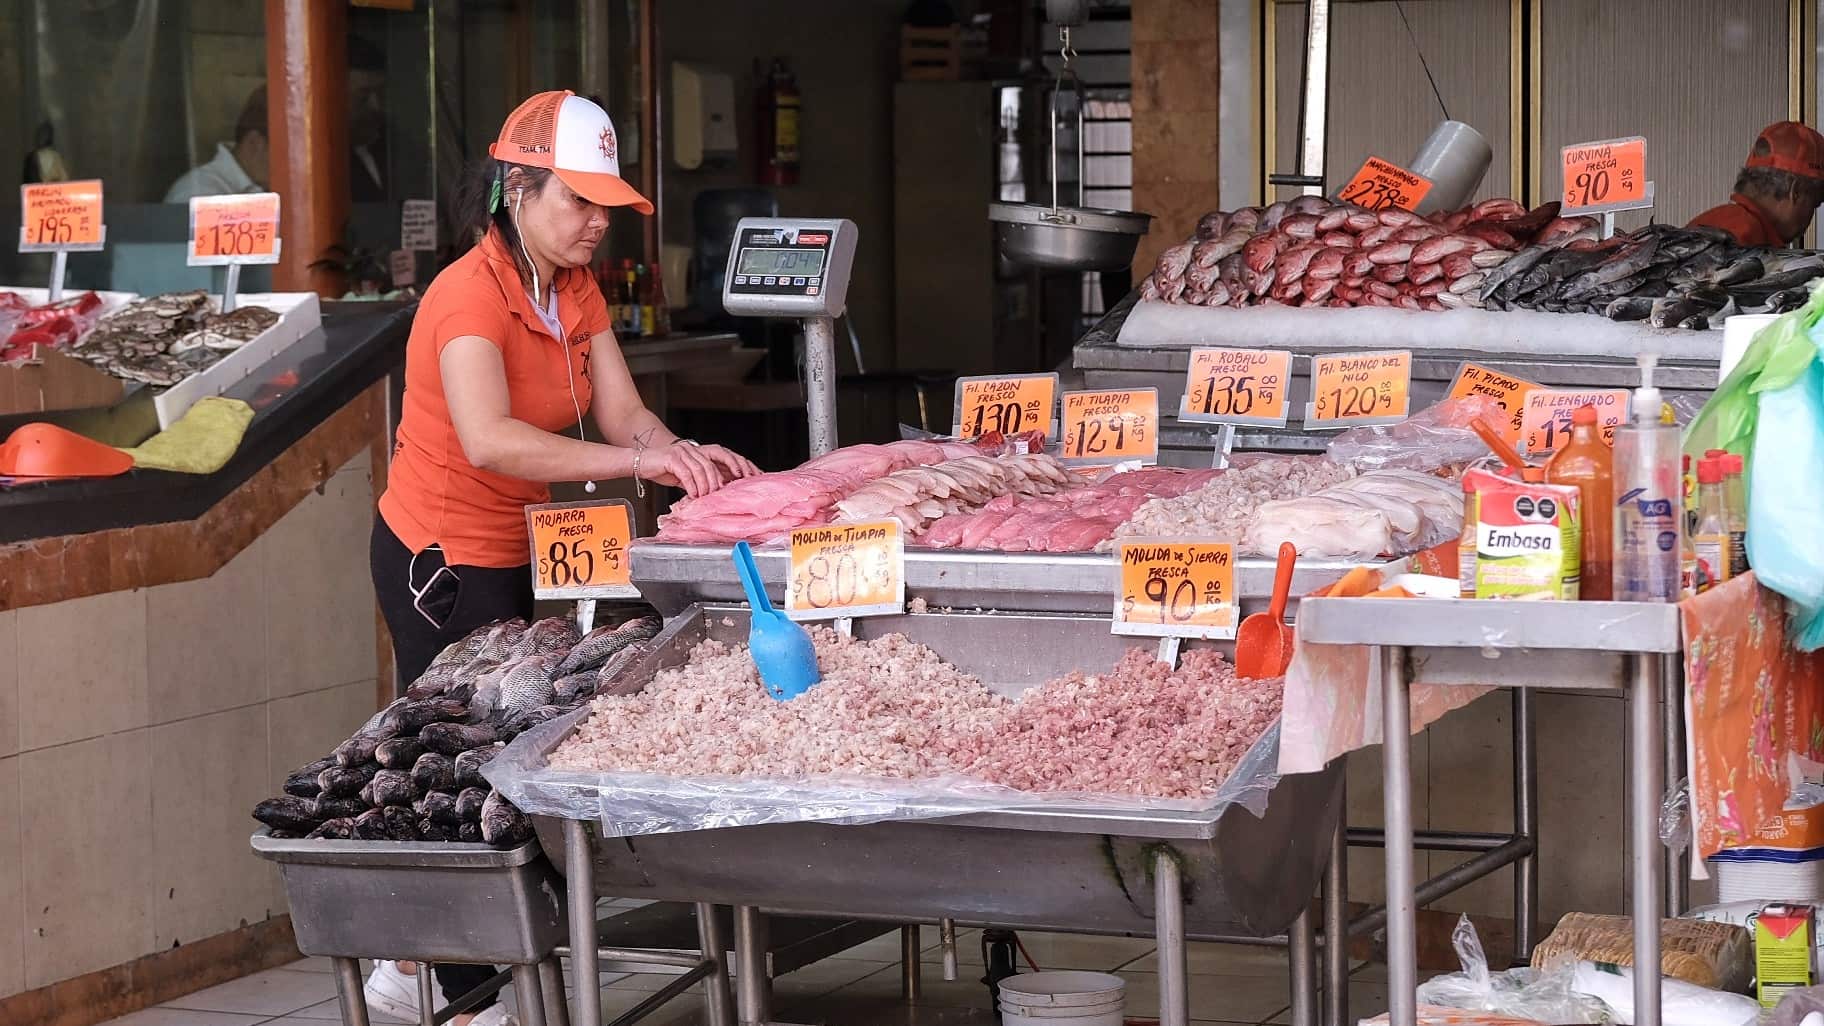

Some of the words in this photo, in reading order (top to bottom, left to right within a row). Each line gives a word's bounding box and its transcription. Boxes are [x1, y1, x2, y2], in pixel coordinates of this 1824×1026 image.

[1566, 146, 1611, 164] CURVINA
[1585, 158, 1617, 172] FRESCA
[1219, 352, 1268, 364] ROBALO
[1210, 364, 1249, 374] FRESCO
[1340, 359, 1379, 372] BLANCO
[1381, 358, 1401, 367] DEL
[983, 380, 1021, 392] CAZON
[1483, 373, 1519, 391] PICADO
[976, 391, 1015, 403] FRESCO
[1471, 384, 1505, 399] FRESCO
[1089, 393, 1130, 405] TILAPIA
[1083, 405, 1119, 417] FRESCO
[1552, 408, 1573, 419] FRE
[535, 510, 585, 528] MOJARRA
[559, 524, 593, 537] FRESCA
[792, 531, 832, 546] MOLIDA
[843, 527, 886, 542] TILAPIA
[1487, 530, 1551, 550] Embasa
[820, 544, 856, 556] FRESCA
[1125, 548, 1171, 565] MOLIDA
[1184, 547, 1229, 566] SIERRA
[1148, 567, 1190, 578] FRESCA
[1206, 580, 1221, 590] 00
